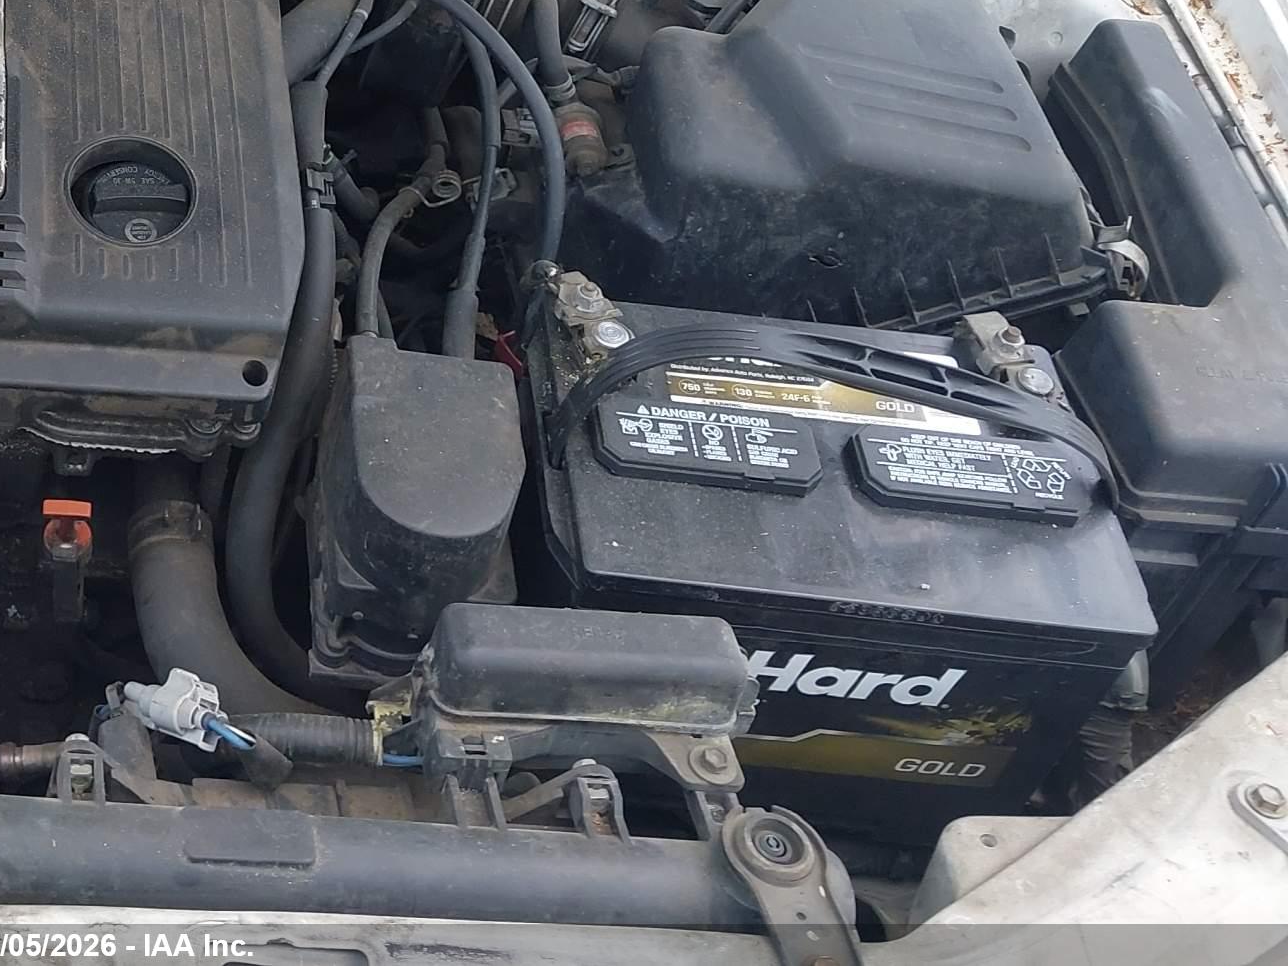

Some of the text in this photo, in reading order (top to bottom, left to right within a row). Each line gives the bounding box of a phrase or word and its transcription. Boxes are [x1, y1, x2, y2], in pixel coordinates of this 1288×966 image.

[682, 382, 701, 391] 750
[735, 387, 753, 397] 130
[876, 401, 915, 413] GOLD
[651, 406, 707, 421] DANGER
[720, 413, 770, 427] POISON
[895, 758, 986, 778] GOLD
